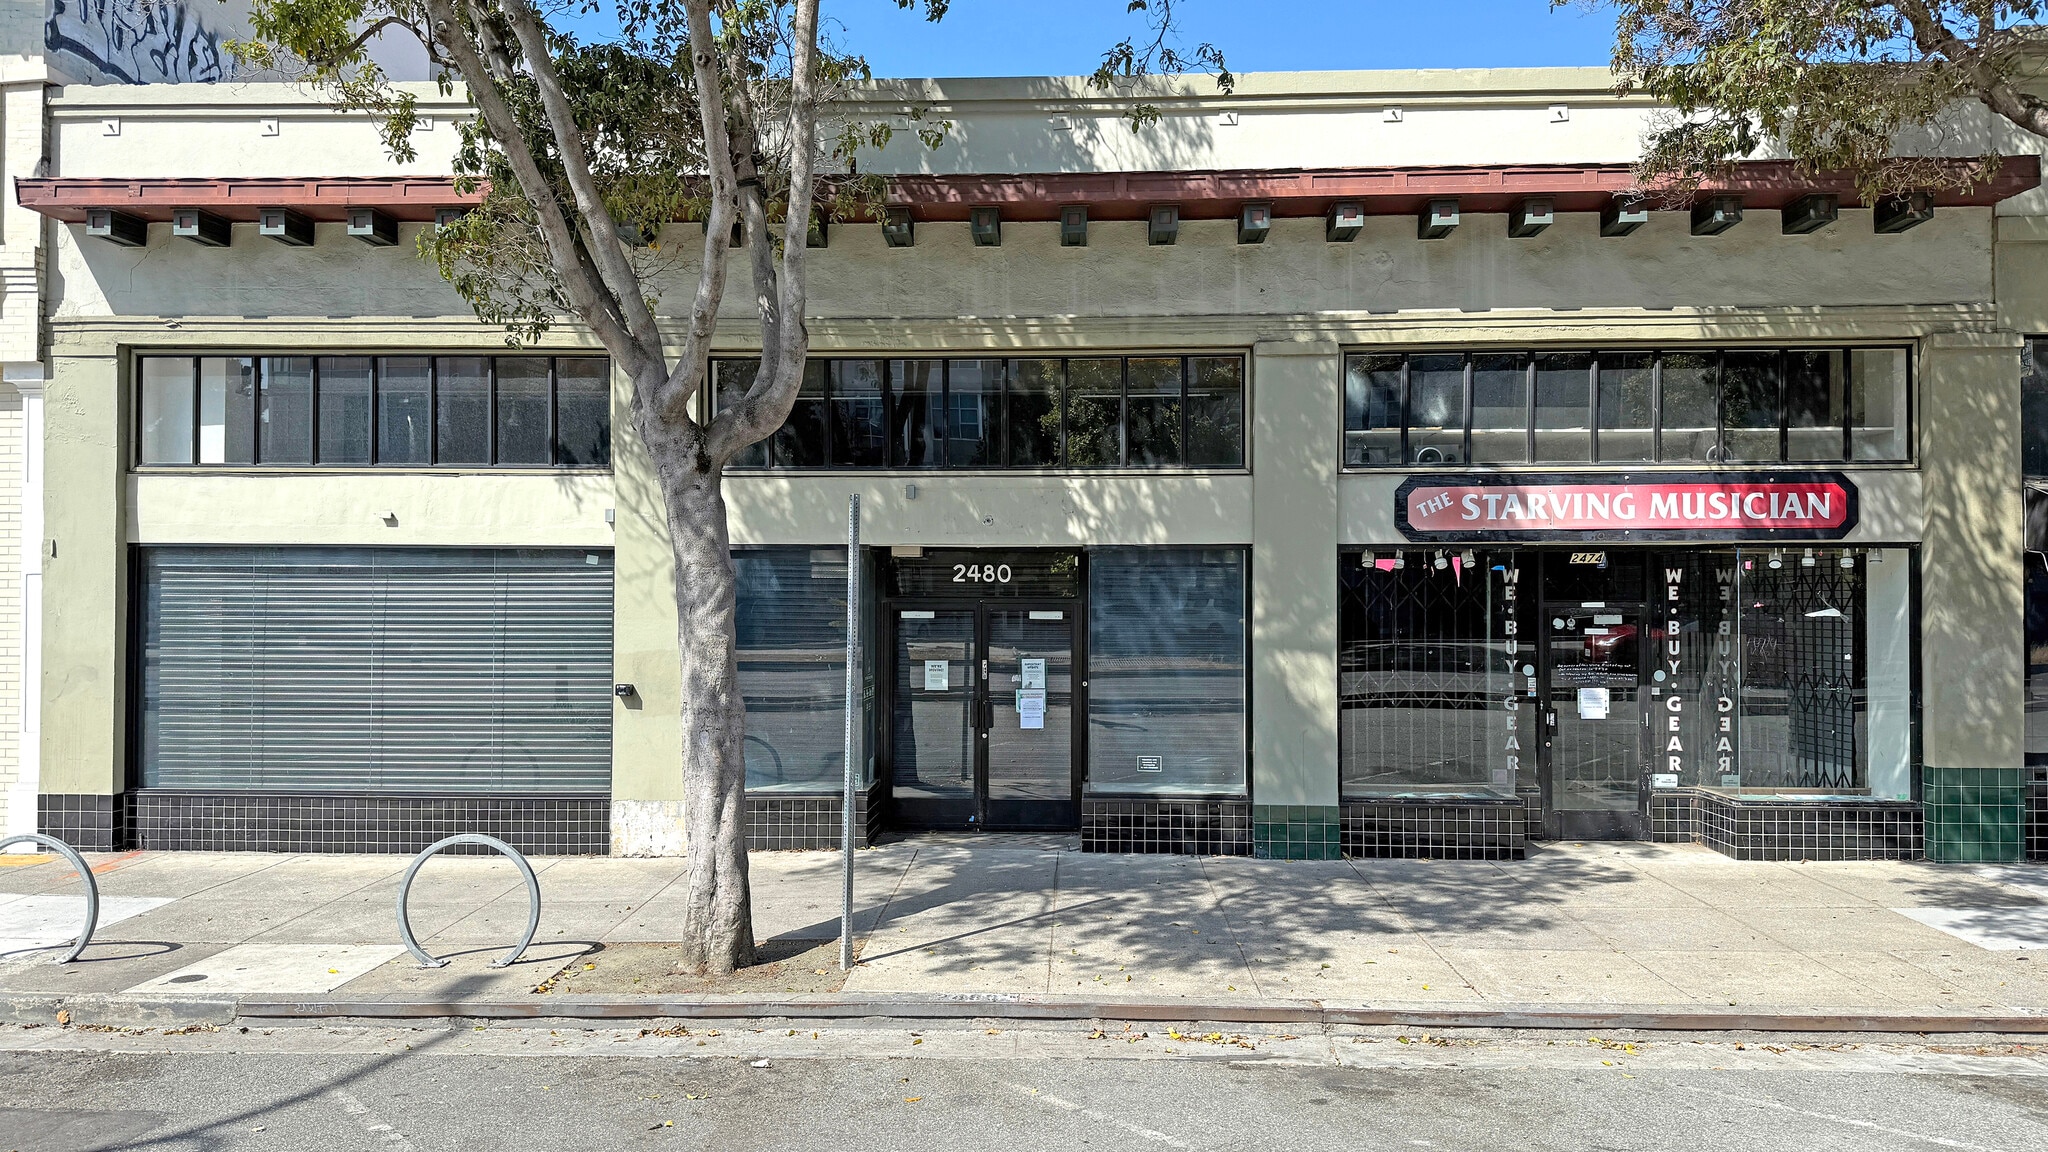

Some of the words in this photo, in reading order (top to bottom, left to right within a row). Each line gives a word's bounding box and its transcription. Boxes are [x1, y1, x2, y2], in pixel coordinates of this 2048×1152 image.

[1416, 491, 1454, 518] THE
[1461, 492, 1636, 521] STARVING
[1648, 492, 1831, 520] MUSICIAN
[952, 564, 1012, 583] 2480
[1571, 553, 1603, 563] 2474
[1503, 568, 1520, 600] WE
[1665, 568, 1683, 600] WE
[1505, 620, 1519, 674] BUY
[1668, 620, 1681, 675] BUY
[1504, 696, 1520, 770] GEAR
[1666, 696, 1683, 771] GEAR
